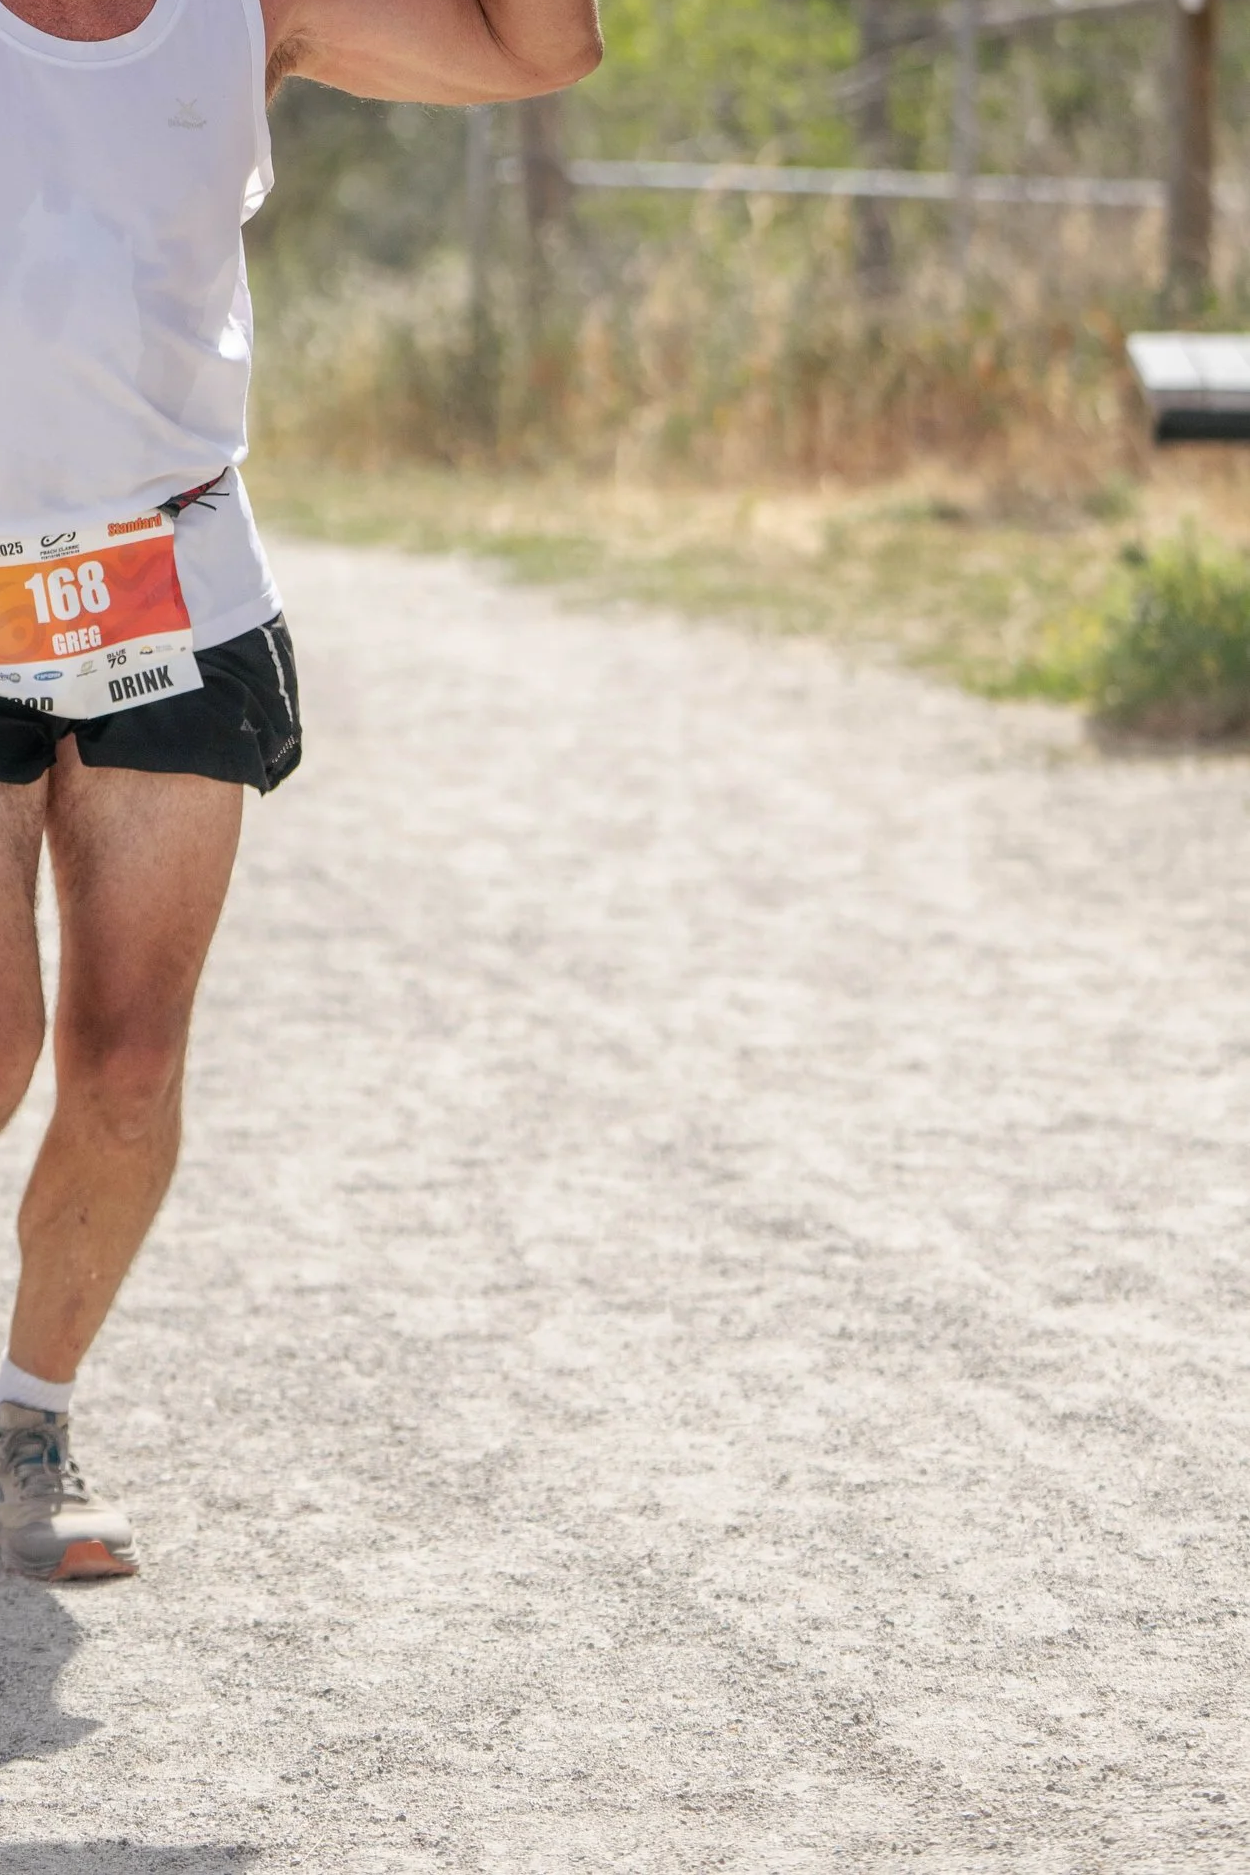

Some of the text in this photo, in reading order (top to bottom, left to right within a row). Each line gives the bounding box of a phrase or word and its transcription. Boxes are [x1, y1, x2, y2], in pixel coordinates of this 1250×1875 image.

[107, 512, 162, 537] Standard
[23, 560, 112, 624] 168
[51, 624, 103, 656] GREG
[106, 648, 127, 659] BLUE
[108, 654, 127, 669] 70
[108, 664, 174, 703] DRINK
